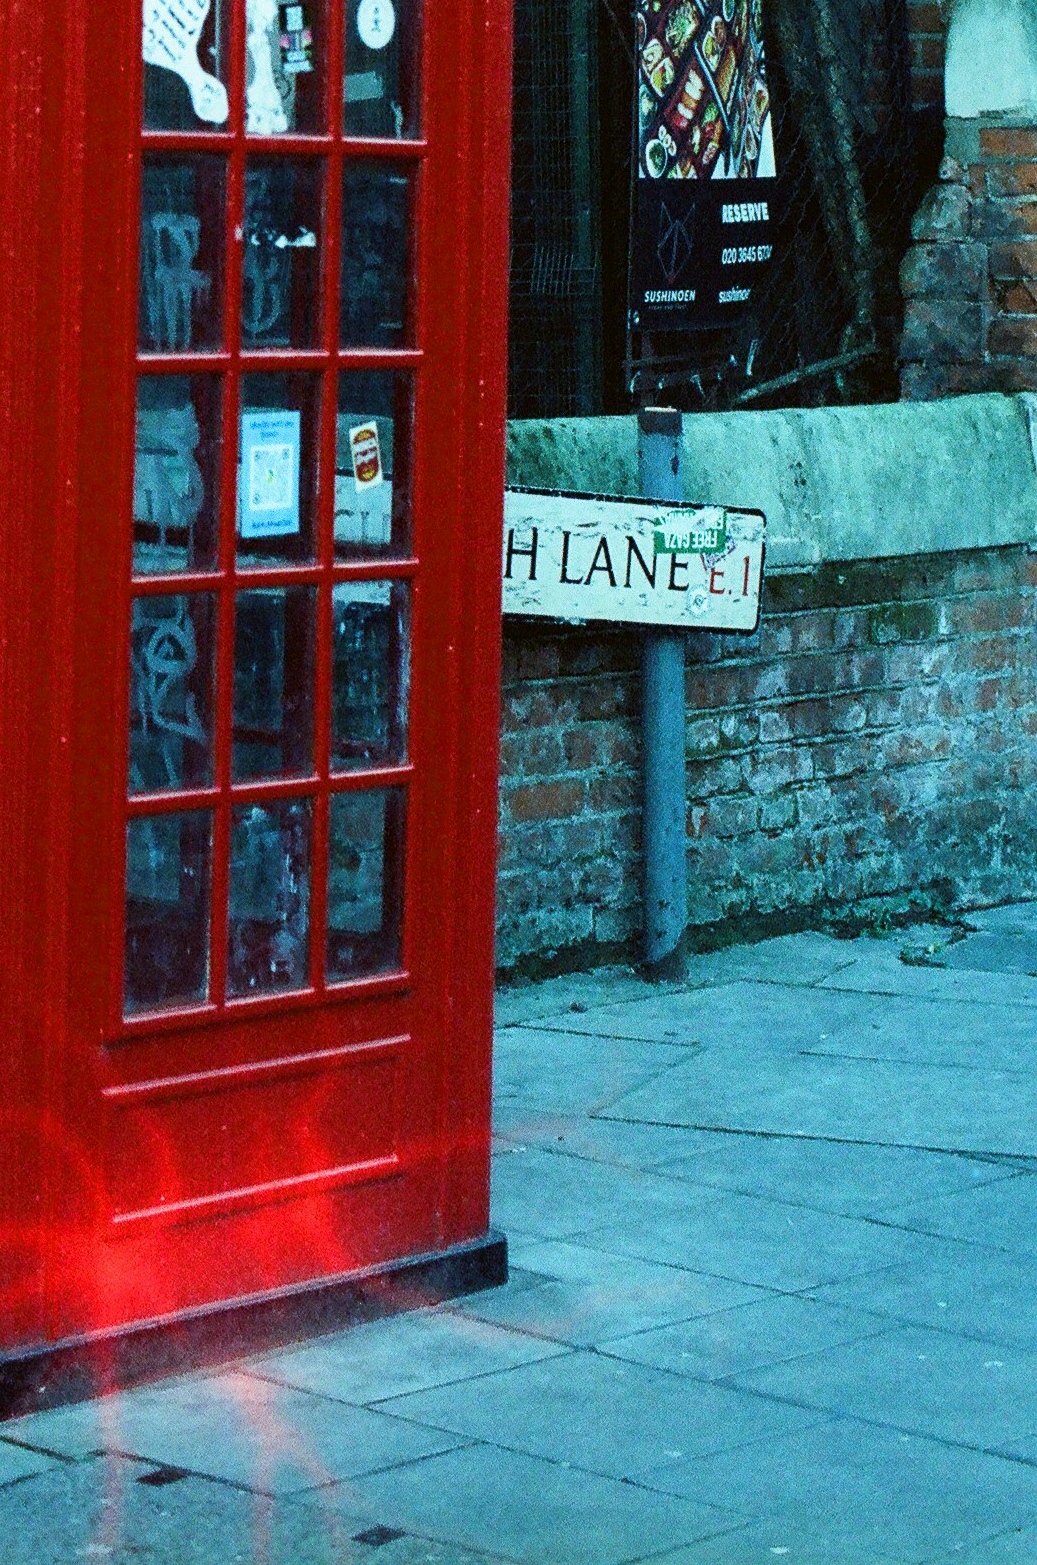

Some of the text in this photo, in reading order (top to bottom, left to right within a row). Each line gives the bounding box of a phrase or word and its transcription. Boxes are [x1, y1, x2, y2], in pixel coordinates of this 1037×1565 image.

[721, 201, 770, 224] RESERVE
[721, 246, 737, 265] 020
[644, 289, 696, 303] SUSHINOEN
[664, 530, 718, 549] FREE GAZA
[559, 530, 690, 592] LANE
